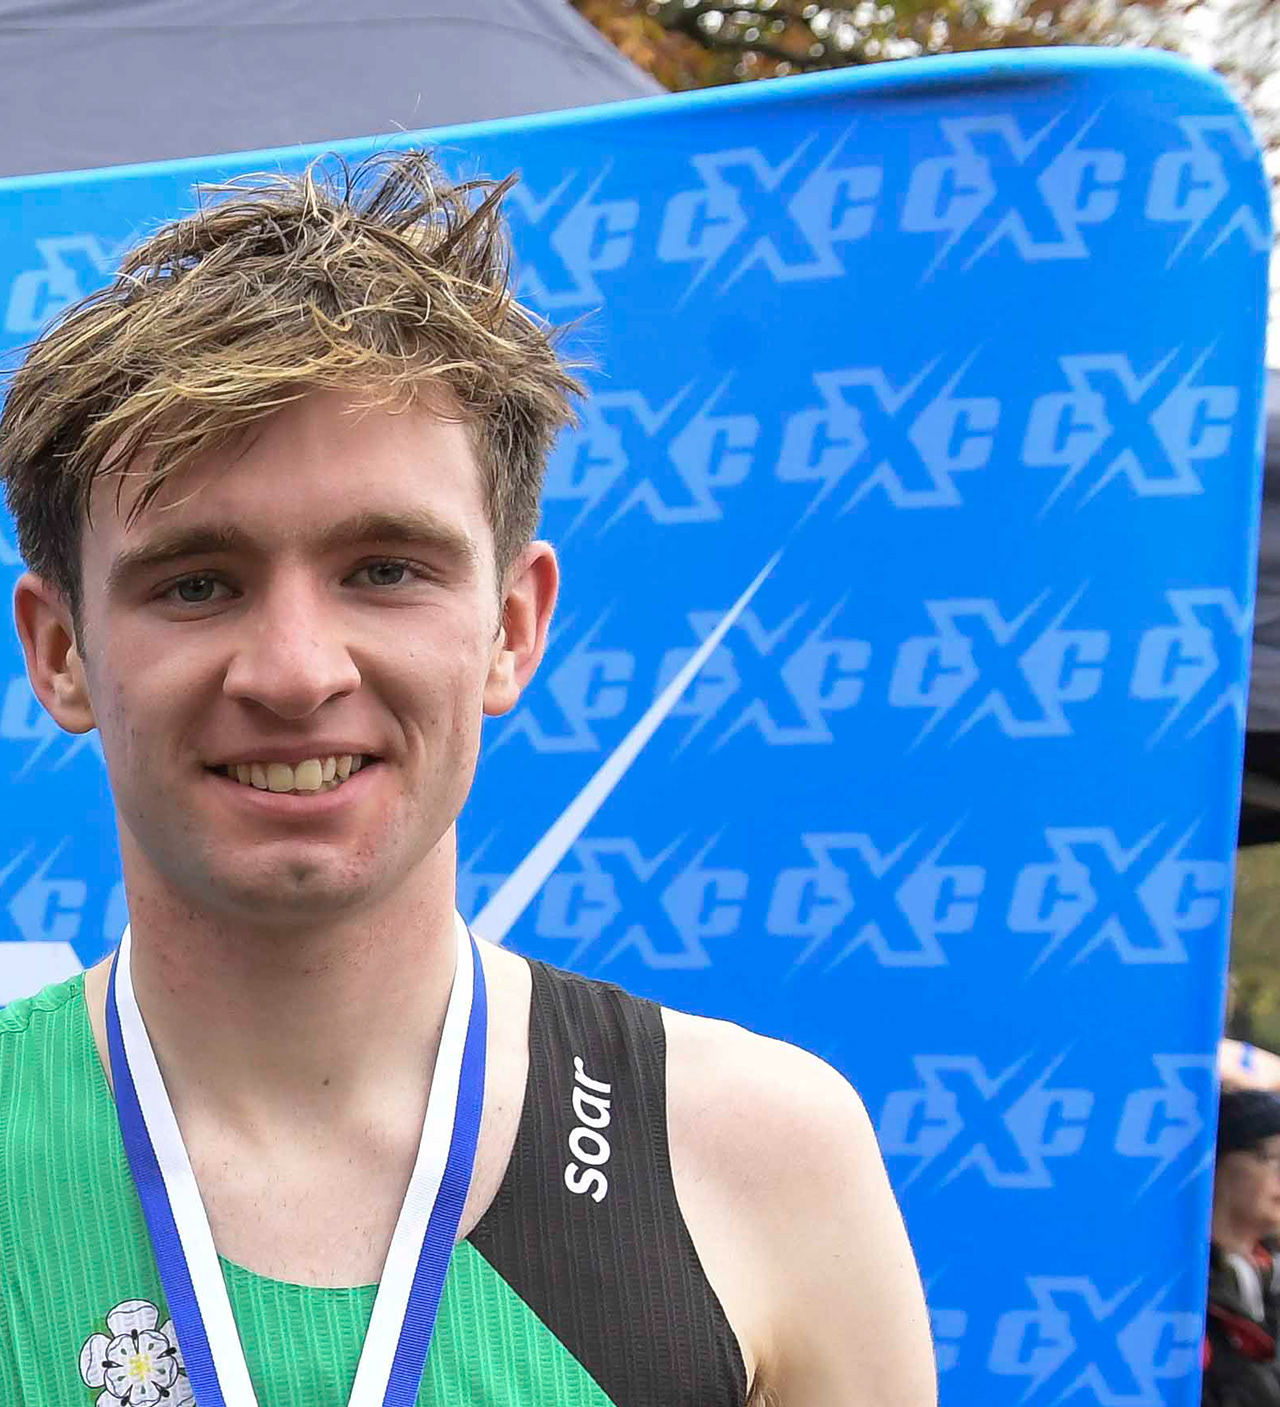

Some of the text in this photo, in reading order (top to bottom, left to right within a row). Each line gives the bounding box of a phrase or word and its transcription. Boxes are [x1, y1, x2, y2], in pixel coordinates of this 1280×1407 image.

[656, 150, 883, 281] CXC
[899, 116, 1125, 259] CXC
[777, 369, 1001, 507] CXC
[1021, 354, 1238, 496] CXC
[889, 600, 1109, 737] CXC
[767, 833, 985, 967] CXC
[1006, 829, 1227, 965] CXC
[565, 1056, 611, 1202] soar
